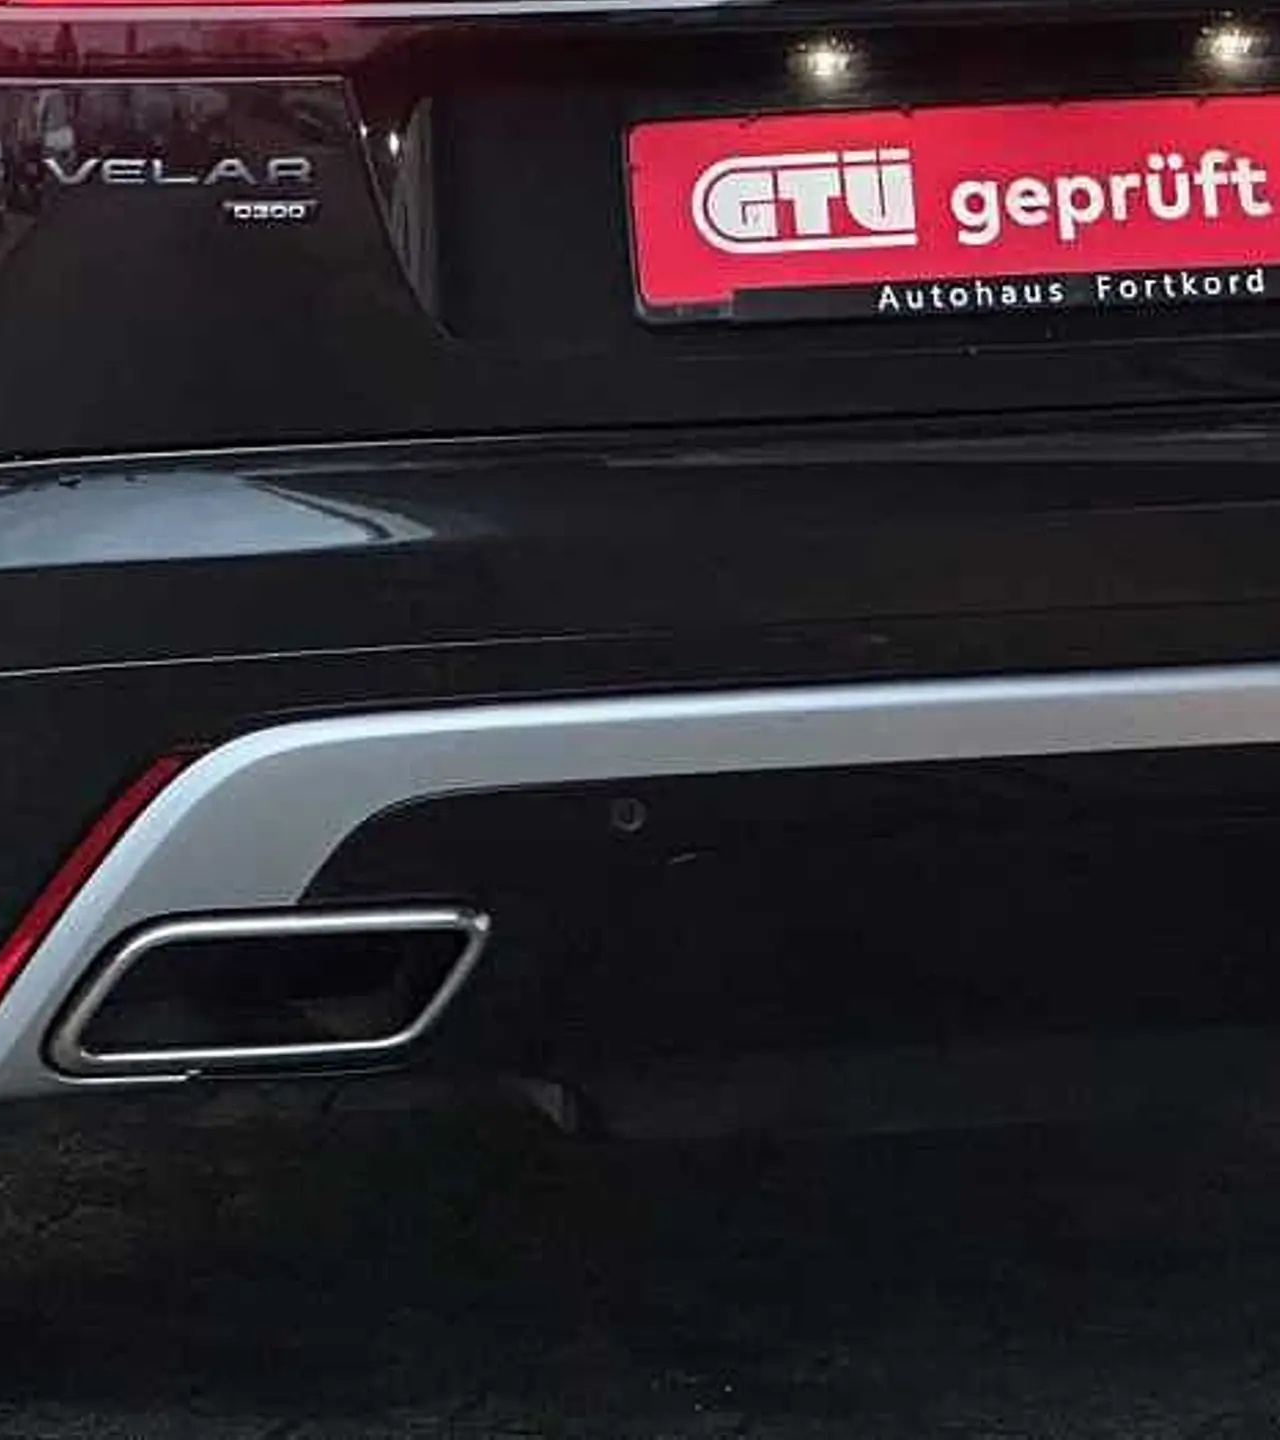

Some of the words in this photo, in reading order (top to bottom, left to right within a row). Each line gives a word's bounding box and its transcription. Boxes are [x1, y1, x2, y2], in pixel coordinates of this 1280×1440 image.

[44, 156, 315, 187] VELAR
[704, 147, 917, 244] GTÜ
[949, 150, 1273, 248] geprüft
[877, 280, 1065, 312] Autohaus
[1095, 269, 1268, 303] Fortkord
